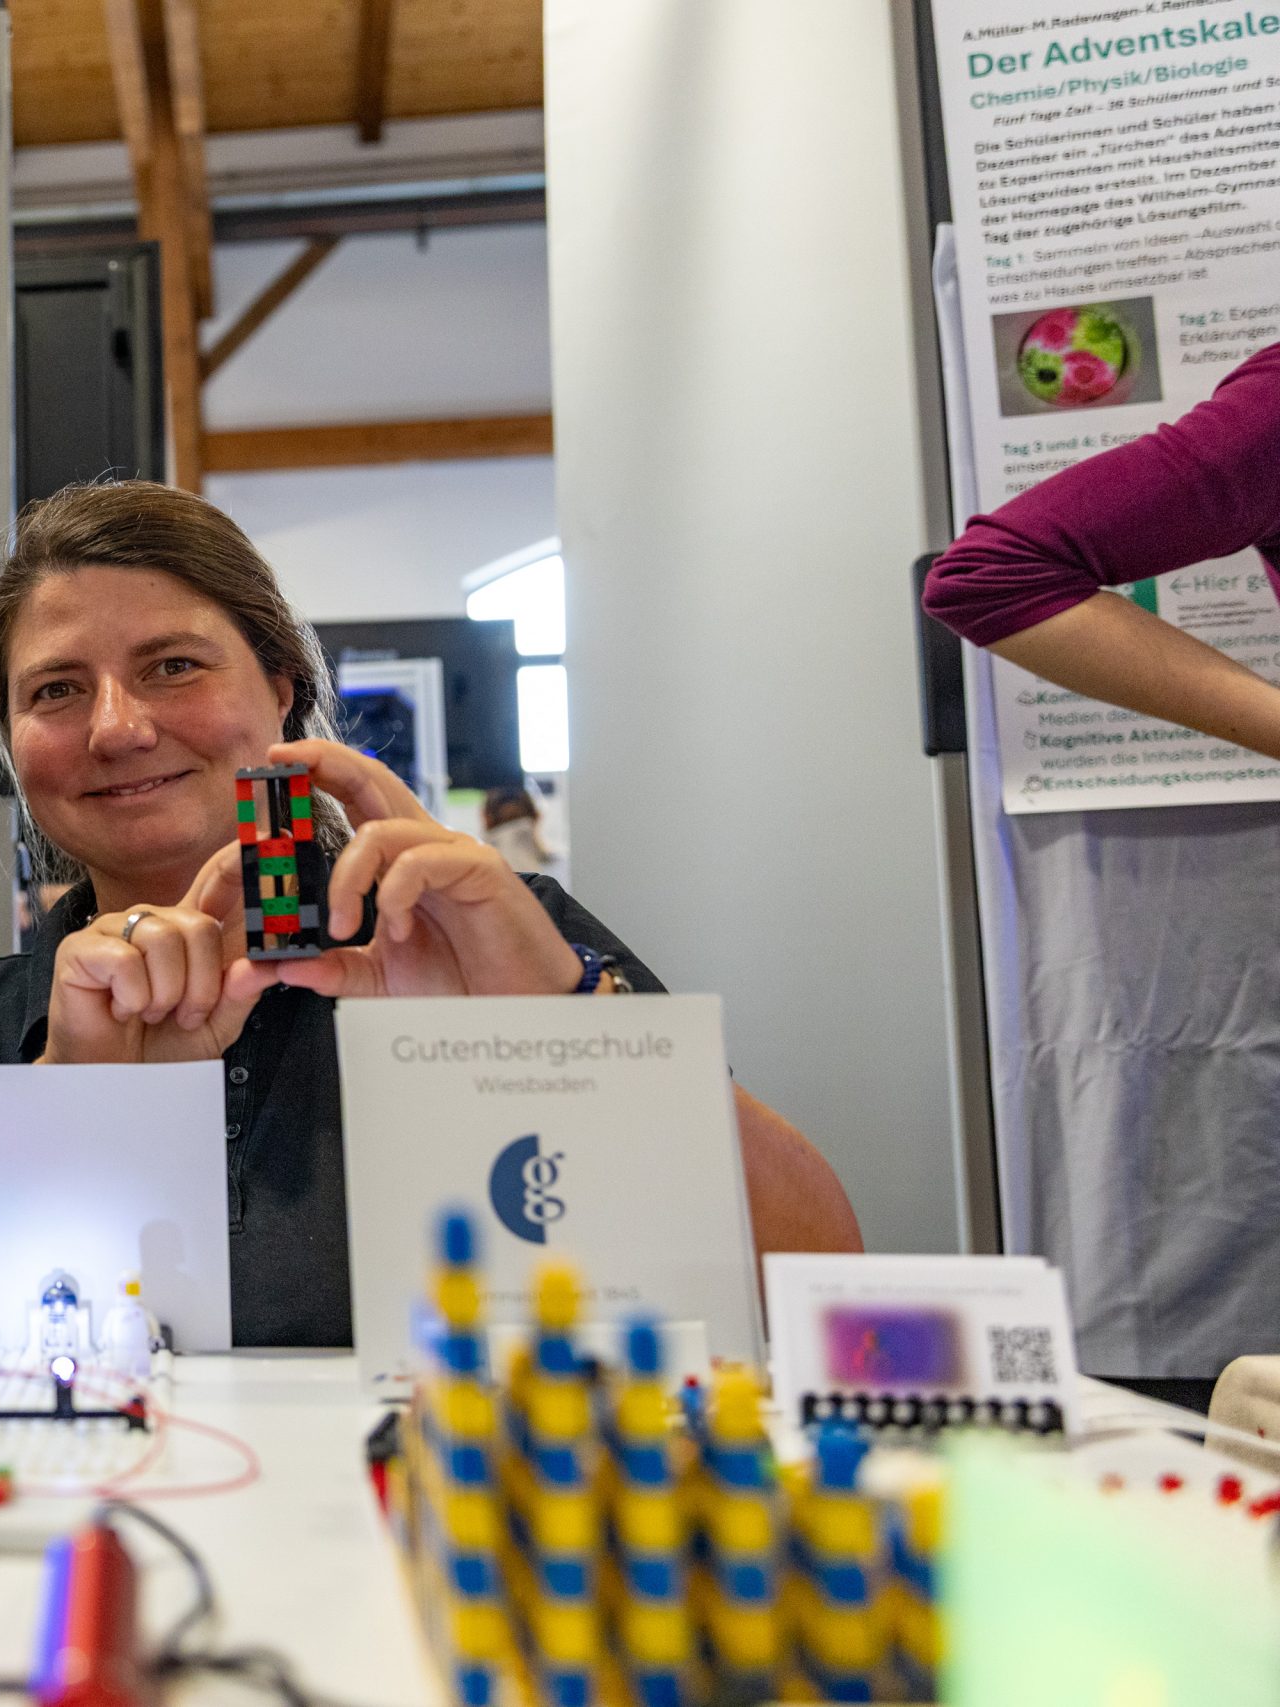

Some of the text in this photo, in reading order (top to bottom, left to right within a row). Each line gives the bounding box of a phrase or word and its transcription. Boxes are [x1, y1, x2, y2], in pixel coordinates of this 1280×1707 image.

[967, 11, 1280, 80] Der Adventskale
[992, 113, 1025, 127] Fünf
[1031, 111, 1062, 122] Tage
[1065, 103, 1093, 118] Zeit
[1128, 85, 1228, 108] Schülerinnen
[1232, 78, 1262, 93] und
[974, 104, 1275, 155] Die Schülerinnen und Schüler haben
[976, 153, 1058, 172] Dezember
[1062, 148, 1087, 159] ein
[1179, 132, 1209, 144] des
[978, 181, 996, 191] zu
[999, 164, 1113, 187] Experimenten
[1117, 157, 1145, 170] mit
[979, 186, 1090, 208] Lösungsvideo
[1164, 172, 1186, 182] Im
[1190, 159, 1276, 180] Dezember
[981, 214, 1008, 226] der
[1010, 201, 1100, 220] Homepage
[1105, 198, 1134, 210] des
[984, 201, 1248, 244] Tag der zugehörige Lösungsfilm.
[986, 233, 1188, 268] Tag Sammeln von Ideen
[986, 263, 1112, 287] Entscheidungen
[1116, 255, 1168, 270] treffen
[989, 266, 1209, 305] was zu Hause umsetzbar ist
[1177, 313, 1207, 327] Tag
[1179, 325, 1278, 347] Erklärungen
[1180, 350, 1241, 365] Aufbau
[1002, 442, 1029, 456] Tag
[1046, 435, 1078, 451] und
[1193, 574, 1241, 592] Hier
[1038, 711, 1104, 727] Medien
[1038, 731, 1124, 750] Kognitive
[1041, 746, 1239, 771] wurden die Inhalte der
[391, 1031, 674, 1066] Gutenbergschule
[473, 1074, 597, 1095] Wiesbaden
